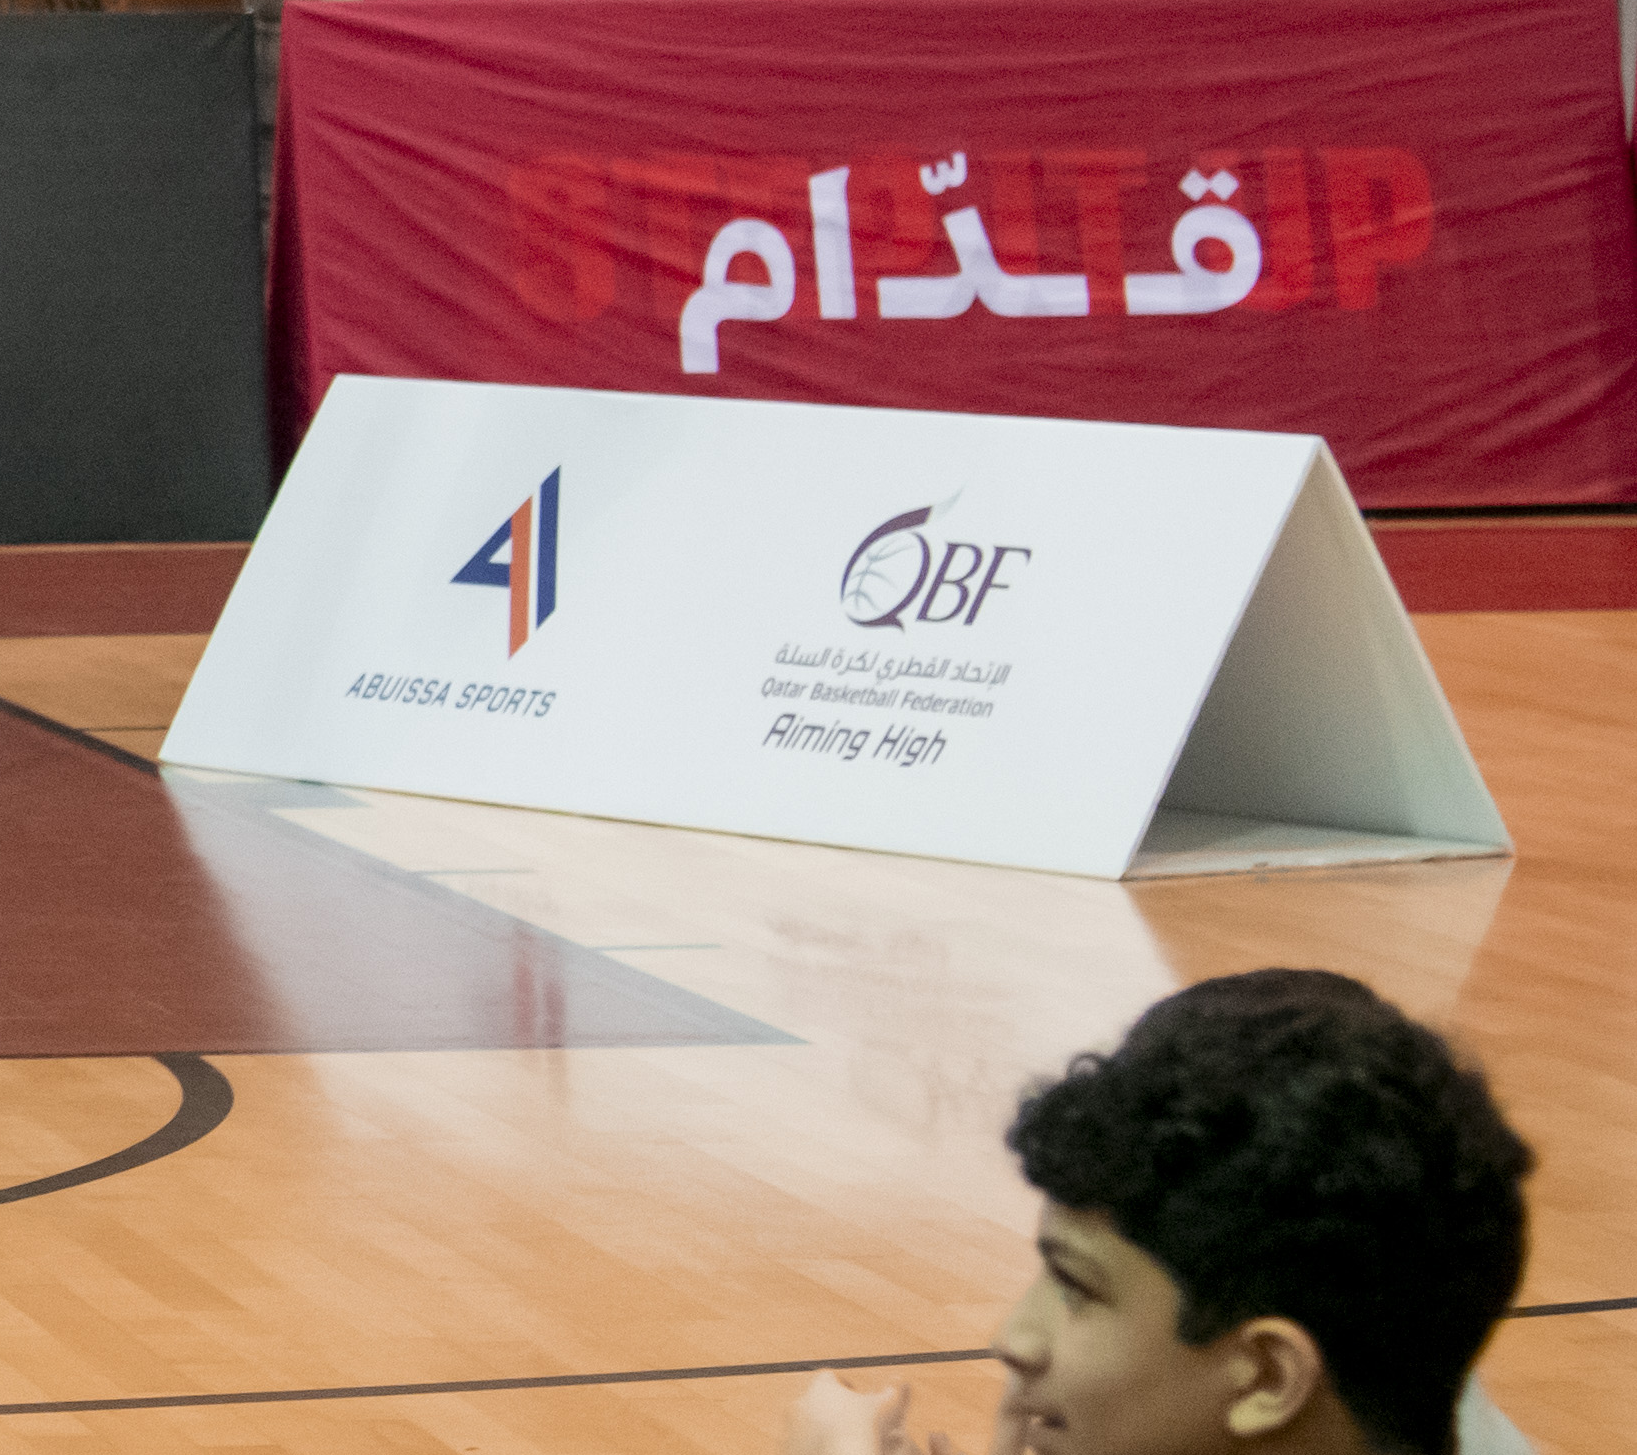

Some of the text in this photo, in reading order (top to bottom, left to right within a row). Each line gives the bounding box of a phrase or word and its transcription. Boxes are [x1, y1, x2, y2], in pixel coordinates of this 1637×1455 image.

[841, 505, 1032, 632] QBF
[345, 673, 556, 717] ABUISSA SPORTS
[761, 677, 994, 718] Qatar Basketball Federation
[762, 713, 947, 768] Aiming High
